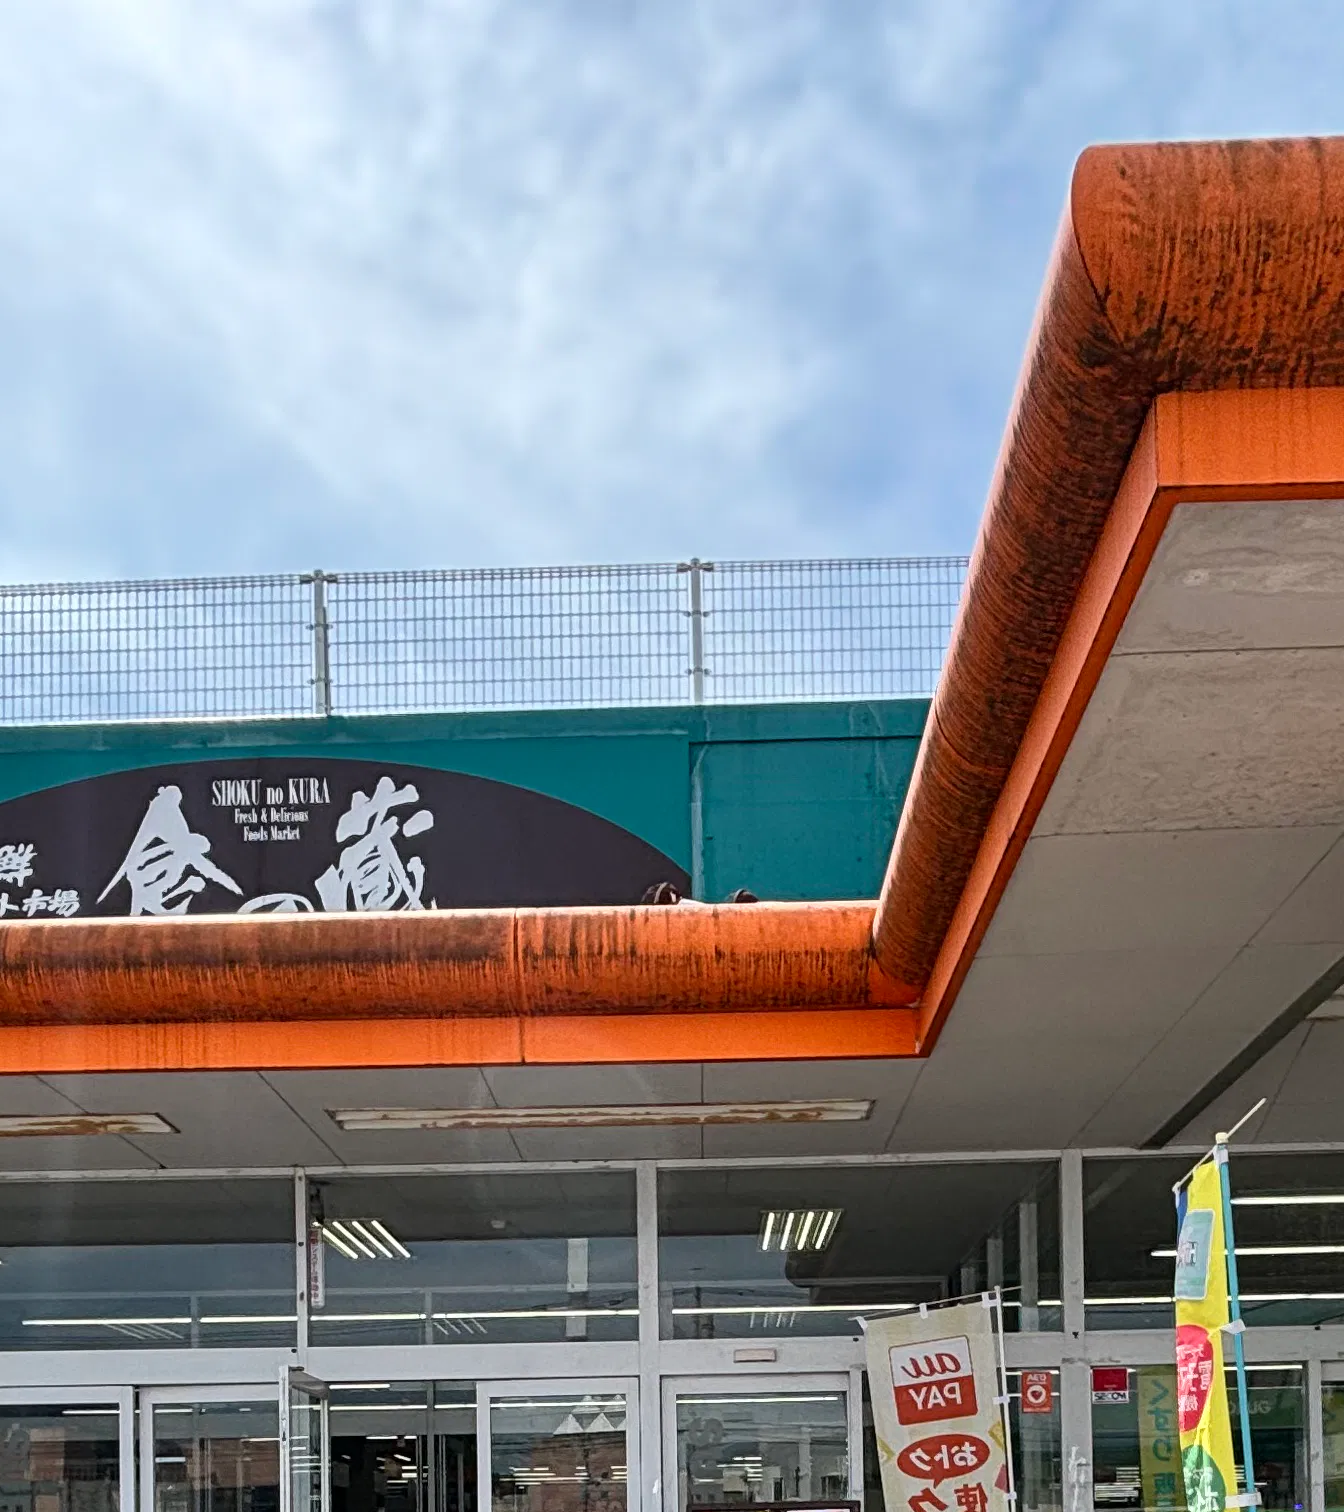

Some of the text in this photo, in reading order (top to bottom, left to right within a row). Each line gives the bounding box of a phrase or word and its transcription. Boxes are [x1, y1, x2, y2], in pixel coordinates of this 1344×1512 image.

[211, 777, 331, 806] SHOKU no KURA
[234, 806, 309, 824] Fresh & Delicious
[243, 825, 301, 842] Foods Market
